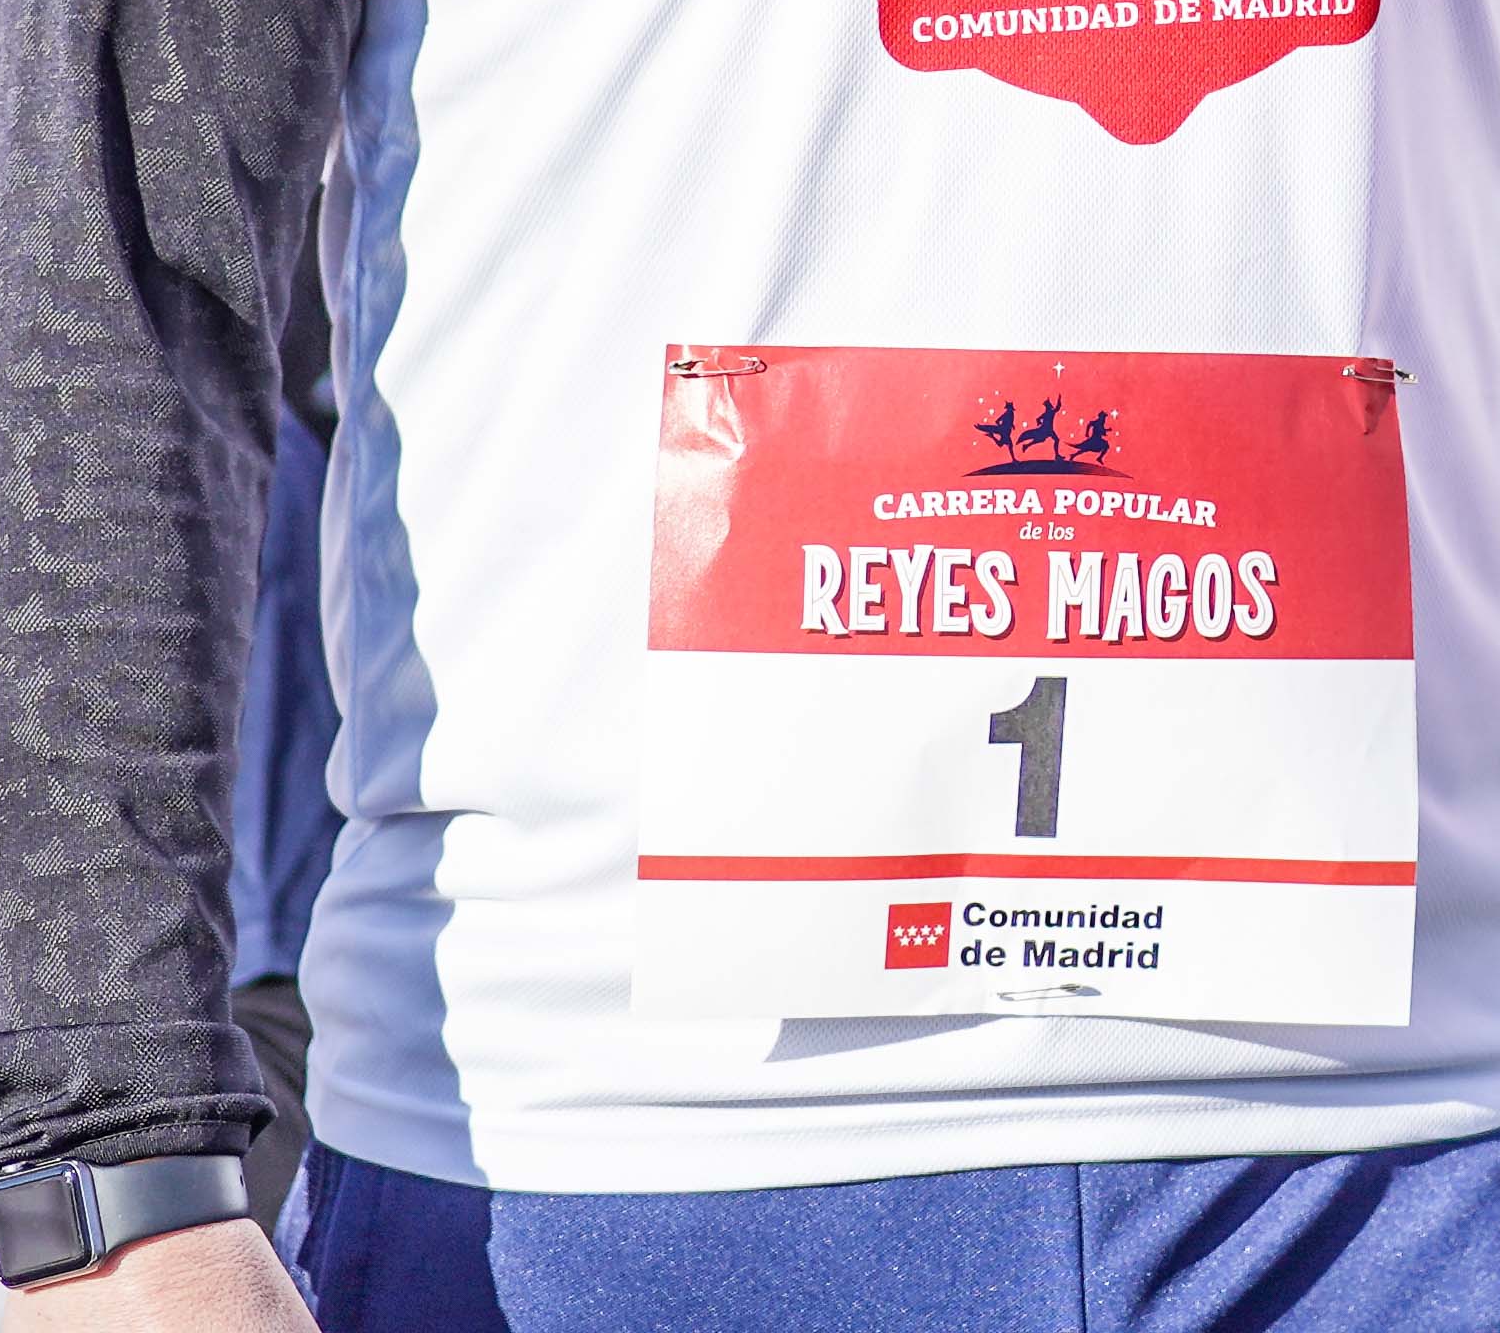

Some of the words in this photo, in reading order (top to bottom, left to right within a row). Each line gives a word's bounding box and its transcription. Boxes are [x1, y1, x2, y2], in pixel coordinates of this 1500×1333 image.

[911, 2, 1138, 44] COMUNIDAD
[873, 489, 1044, 520] CARRERA
[1053, 489, 1217, 528] POPULAR
[1019, 522, 1044, 541] de
[1048, 523, 1074, 541] los
[802, 545, 1017, 638] REYES
[1047, 551, 1277, 642] MAGOS
[988, 677, 1068, 837] 1
[963, 903, 1163, 930] Comunidad
[960, 942, 1006, 968] de
[1023, 941, 1159, 970] Madrid
